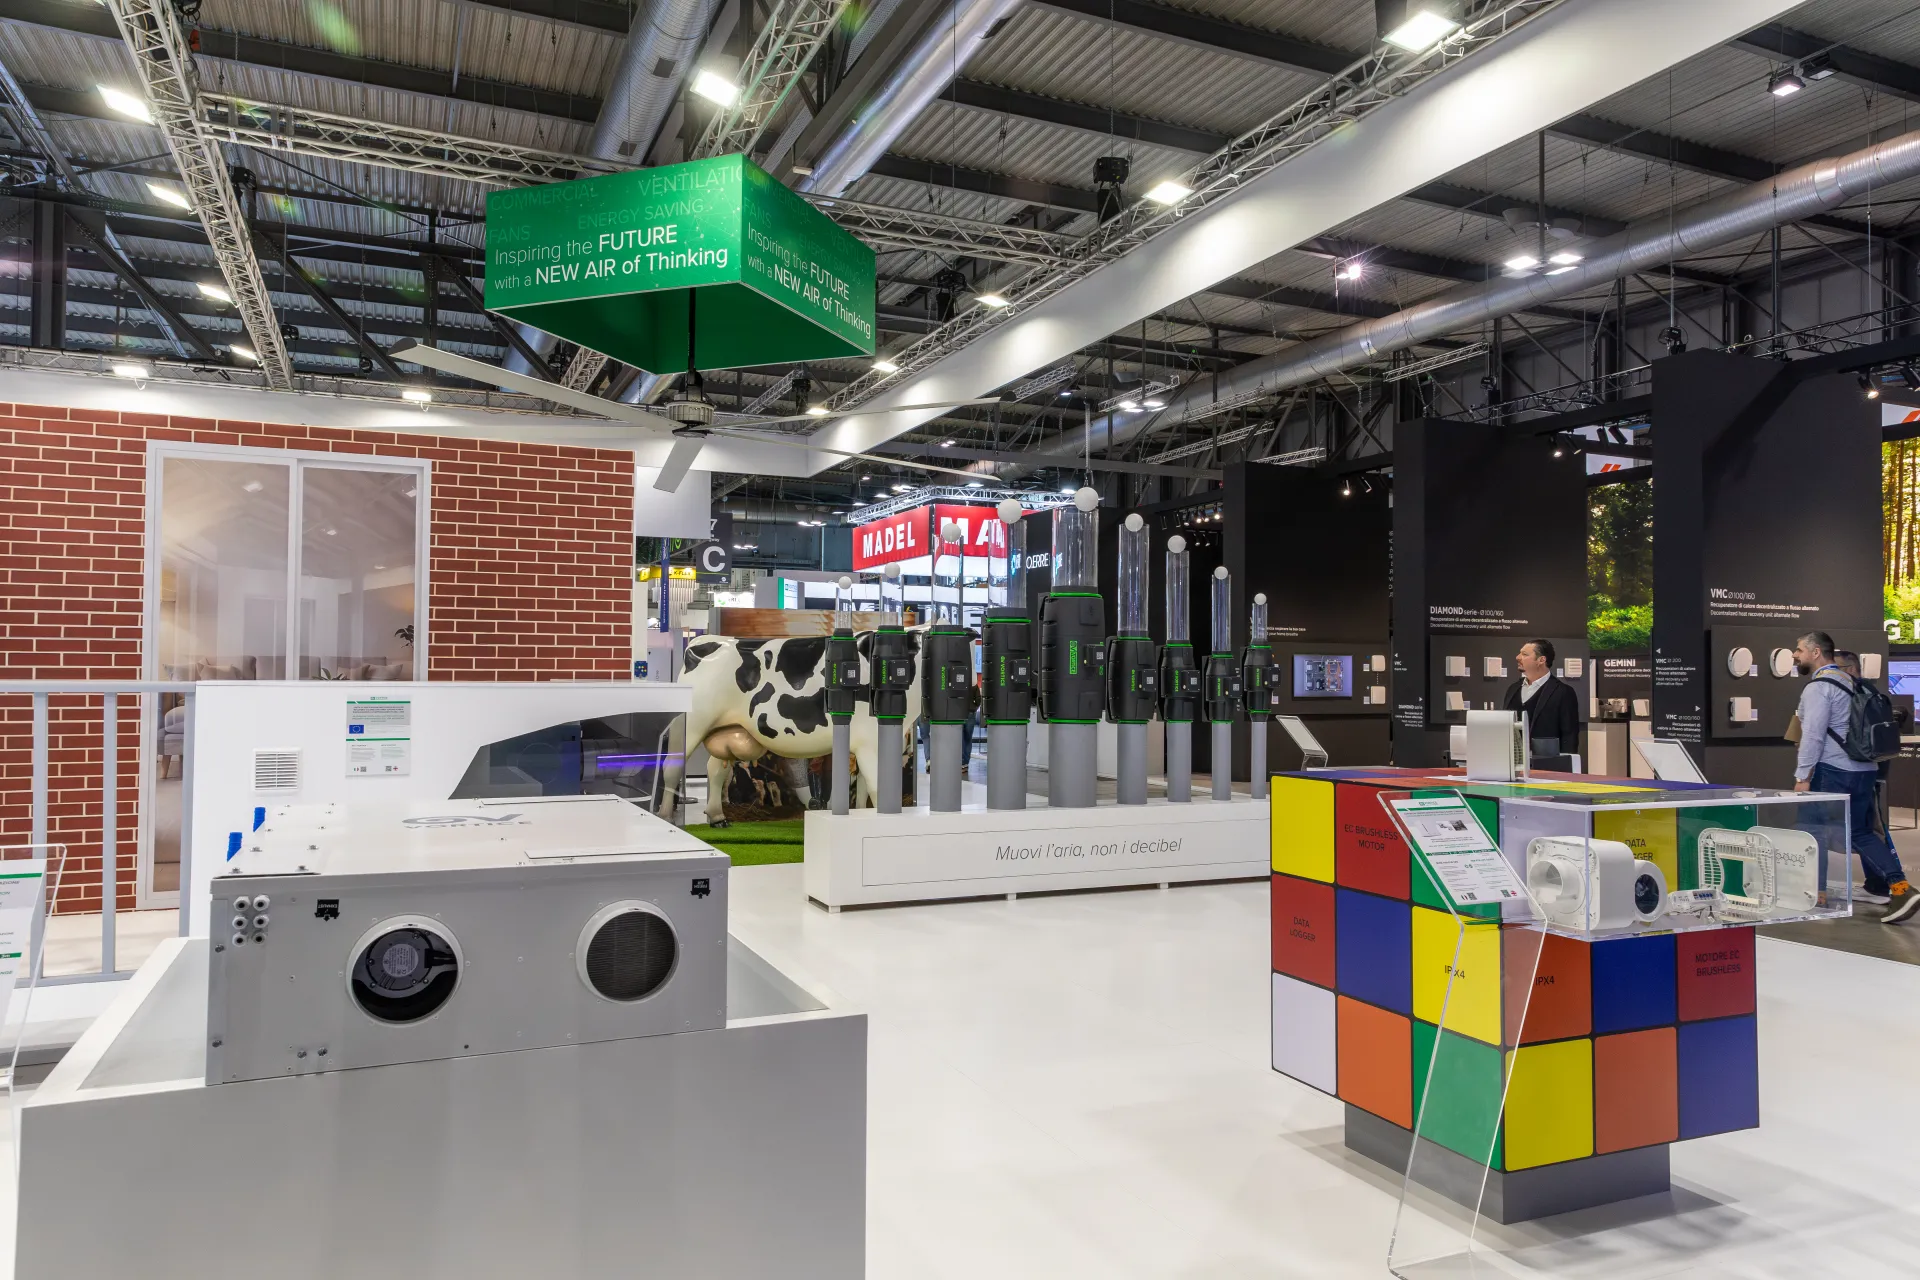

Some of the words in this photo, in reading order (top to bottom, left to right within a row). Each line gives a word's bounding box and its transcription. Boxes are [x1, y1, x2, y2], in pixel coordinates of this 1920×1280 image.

[578, 207, 639, 230] ENERGY
[644, 198, 704, 222] SAVING
[489, 225, 531, 245] FANS
[495, 243, 561, 267] Inspiring
[567, 238, 592, 257] the
[599, 224, 678, 253] FUTURE
[494, 273, 520, 290] with
[524, 275, 532, 287] a
[535, 262, 580, 285] NEW
[584, 258, 616, 280] AIR
[622, 254, 641, 275] of
[646, 247, 728, 272] Thinking
[748, 222, 790, 267] Inspiring
[793, 252, 808, 275] the
[810, 260, 850, 301] FUTURE
[747, 253, 765, 274] with
[767, 265, 772, 279] a
[774, 263, 801, 294] NEW
[802, 282, 820, 307] AIR
[822, 296, 832, 314] of
[834, 301, 872, 340] Thinking
[863, 522, 916, 559] MADEL
[702, 546, 726, 572] C
[1710, 588, 1728, 599] VMC
[1430, 606, 1464, 615] DIAMOND
[1604, 658, 1636, 667] GEMINI
[1344, 824, 1354, 833] EC
[1355, 825, 1398, 840] BRUSHLESS
[996, 845, 1042, 861] Muovi
[1090, 843, 1118, 856] non
[1122, 841, 1126, 854] i
[1130, 838, 1182, 854] decibel
[1358, 839, 1385, 851] MOTOR
[1625, 839, 1646, 847] DATA
[1294, 916, 1310, 928] DATA
[1290, 928, 1316, 942] LOGGER
[1696, 951, 1727, 963] MOTORE
[1730, 950, 1739, 960] EC
[1444, 964, 1465, 979] IPX4
[1696, 964, 1741, 976] BRUSHLESS
[1535, 975, 1555, 986] IPX4
